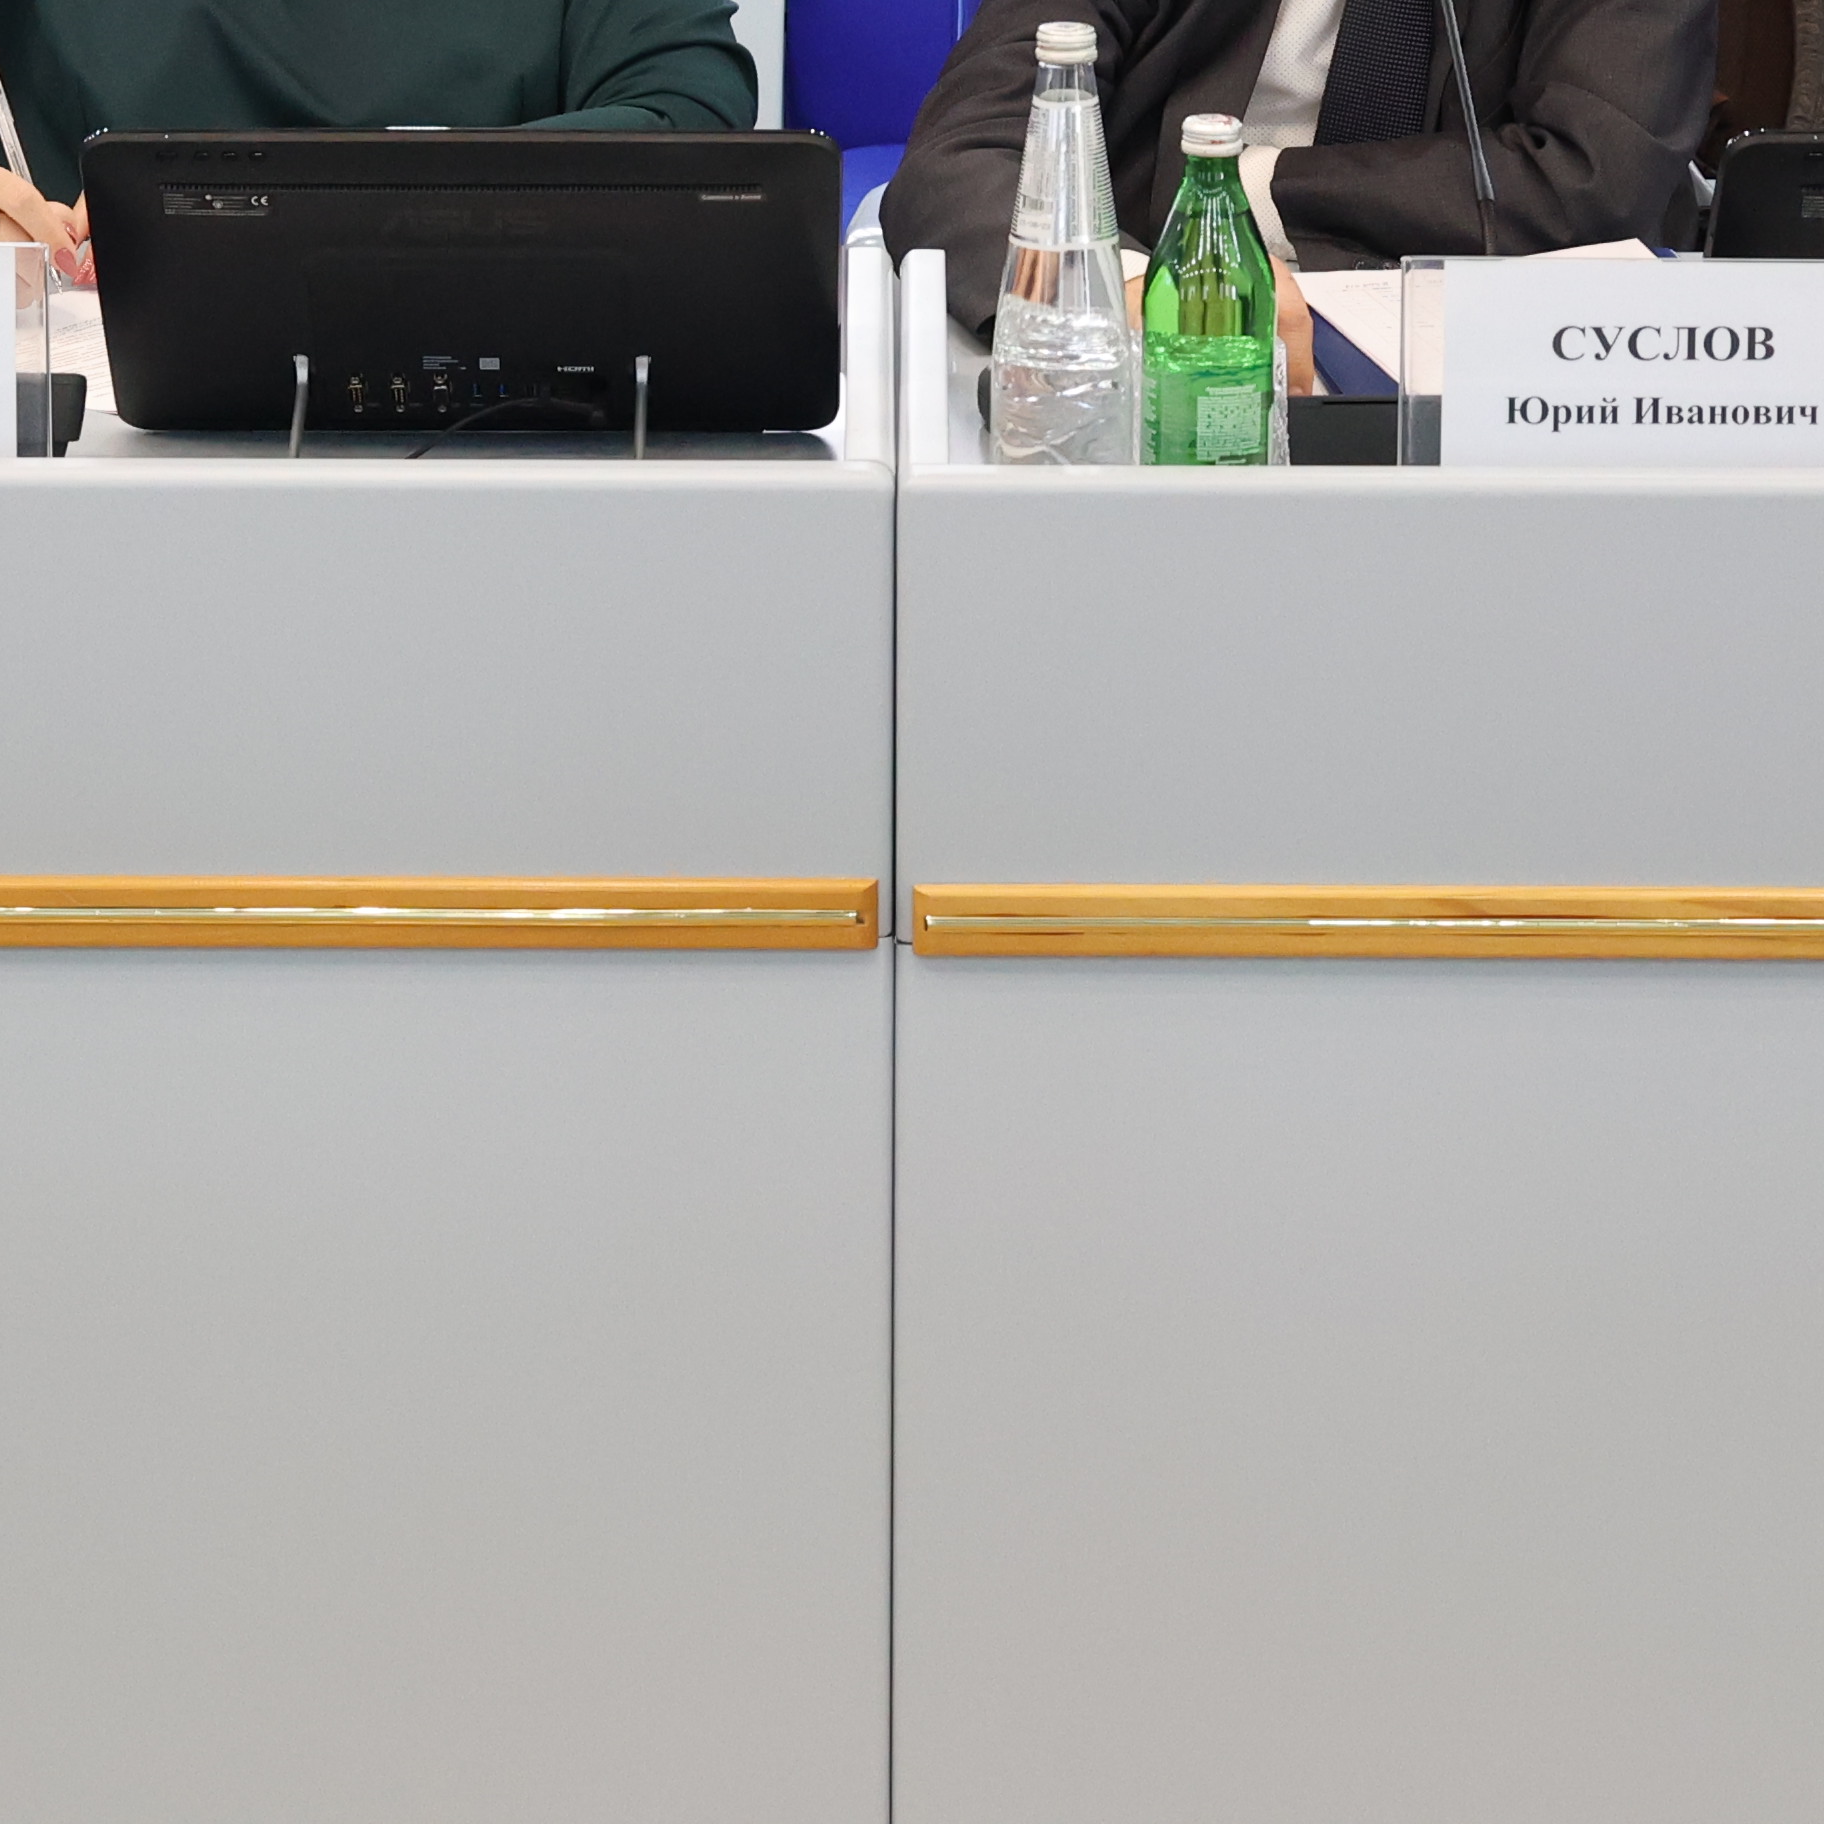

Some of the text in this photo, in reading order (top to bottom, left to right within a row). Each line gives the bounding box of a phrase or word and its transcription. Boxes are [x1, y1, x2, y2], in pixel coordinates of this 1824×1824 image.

[1552, 326, 1774, 361] СУСЛОВ
[1508, 397, 1817, 432] Юрий Иванович
